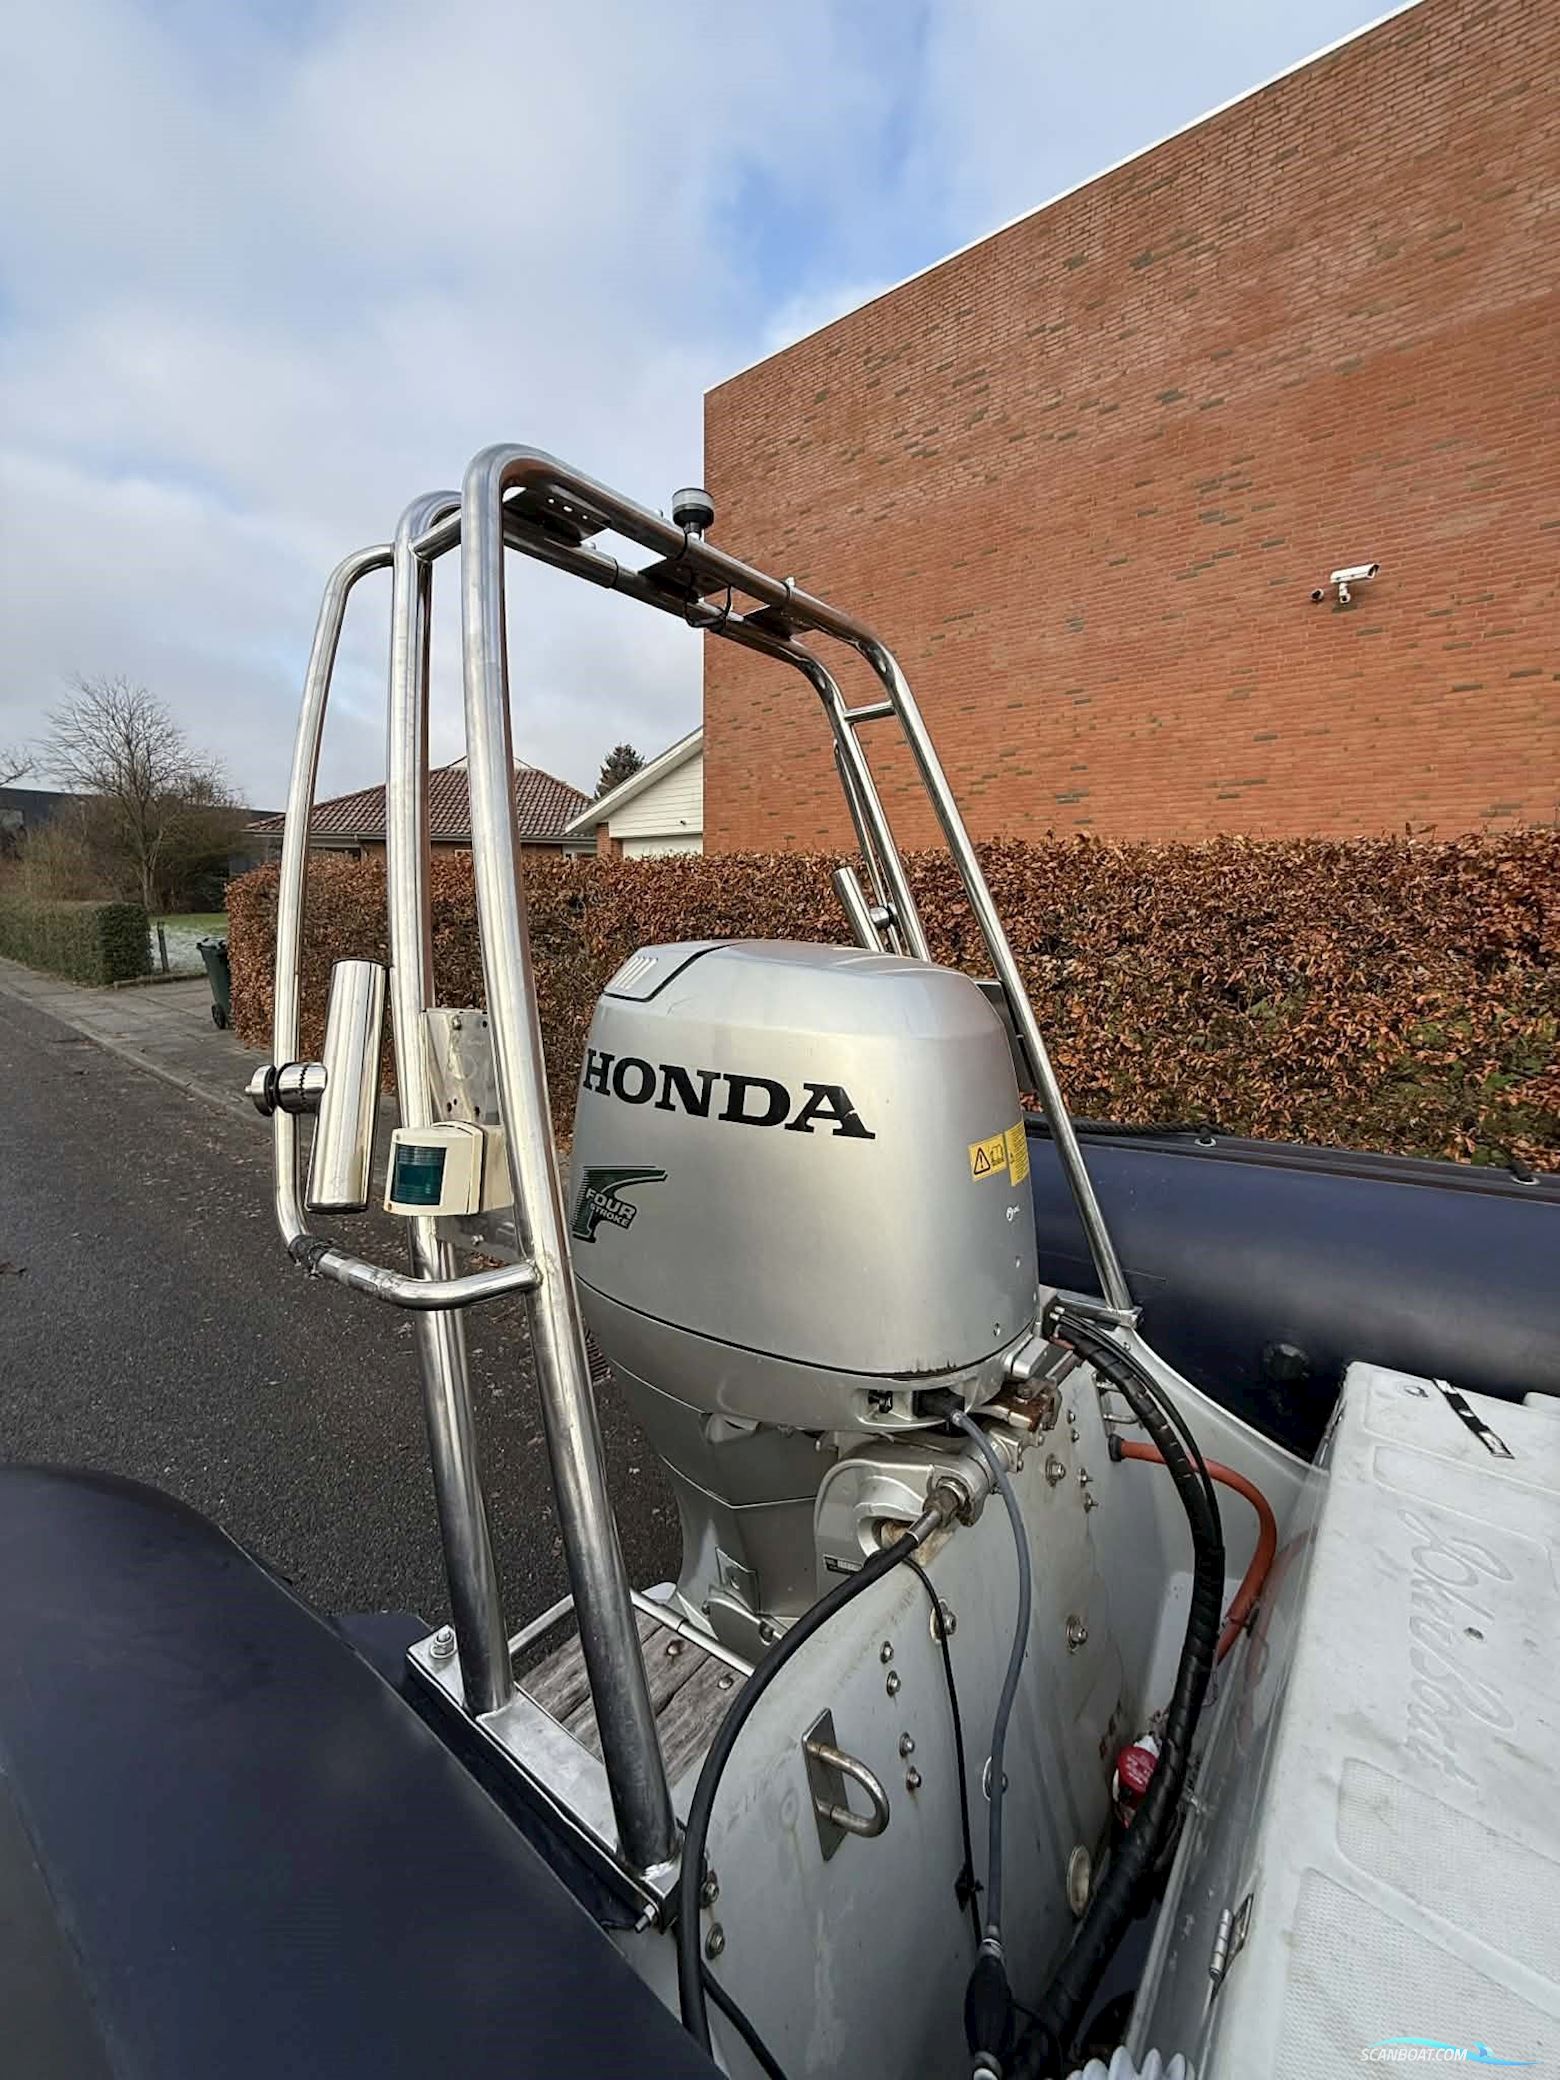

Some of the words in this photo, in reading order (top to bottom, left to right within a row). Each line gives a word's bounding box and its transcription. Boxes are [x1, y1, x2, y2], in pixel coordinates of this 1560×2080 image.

[583, 1048, 876, 1140] HONDA
[586, 1188, 636, 1220] FOUR
[590, 1203, 631, 1228] STROKE
